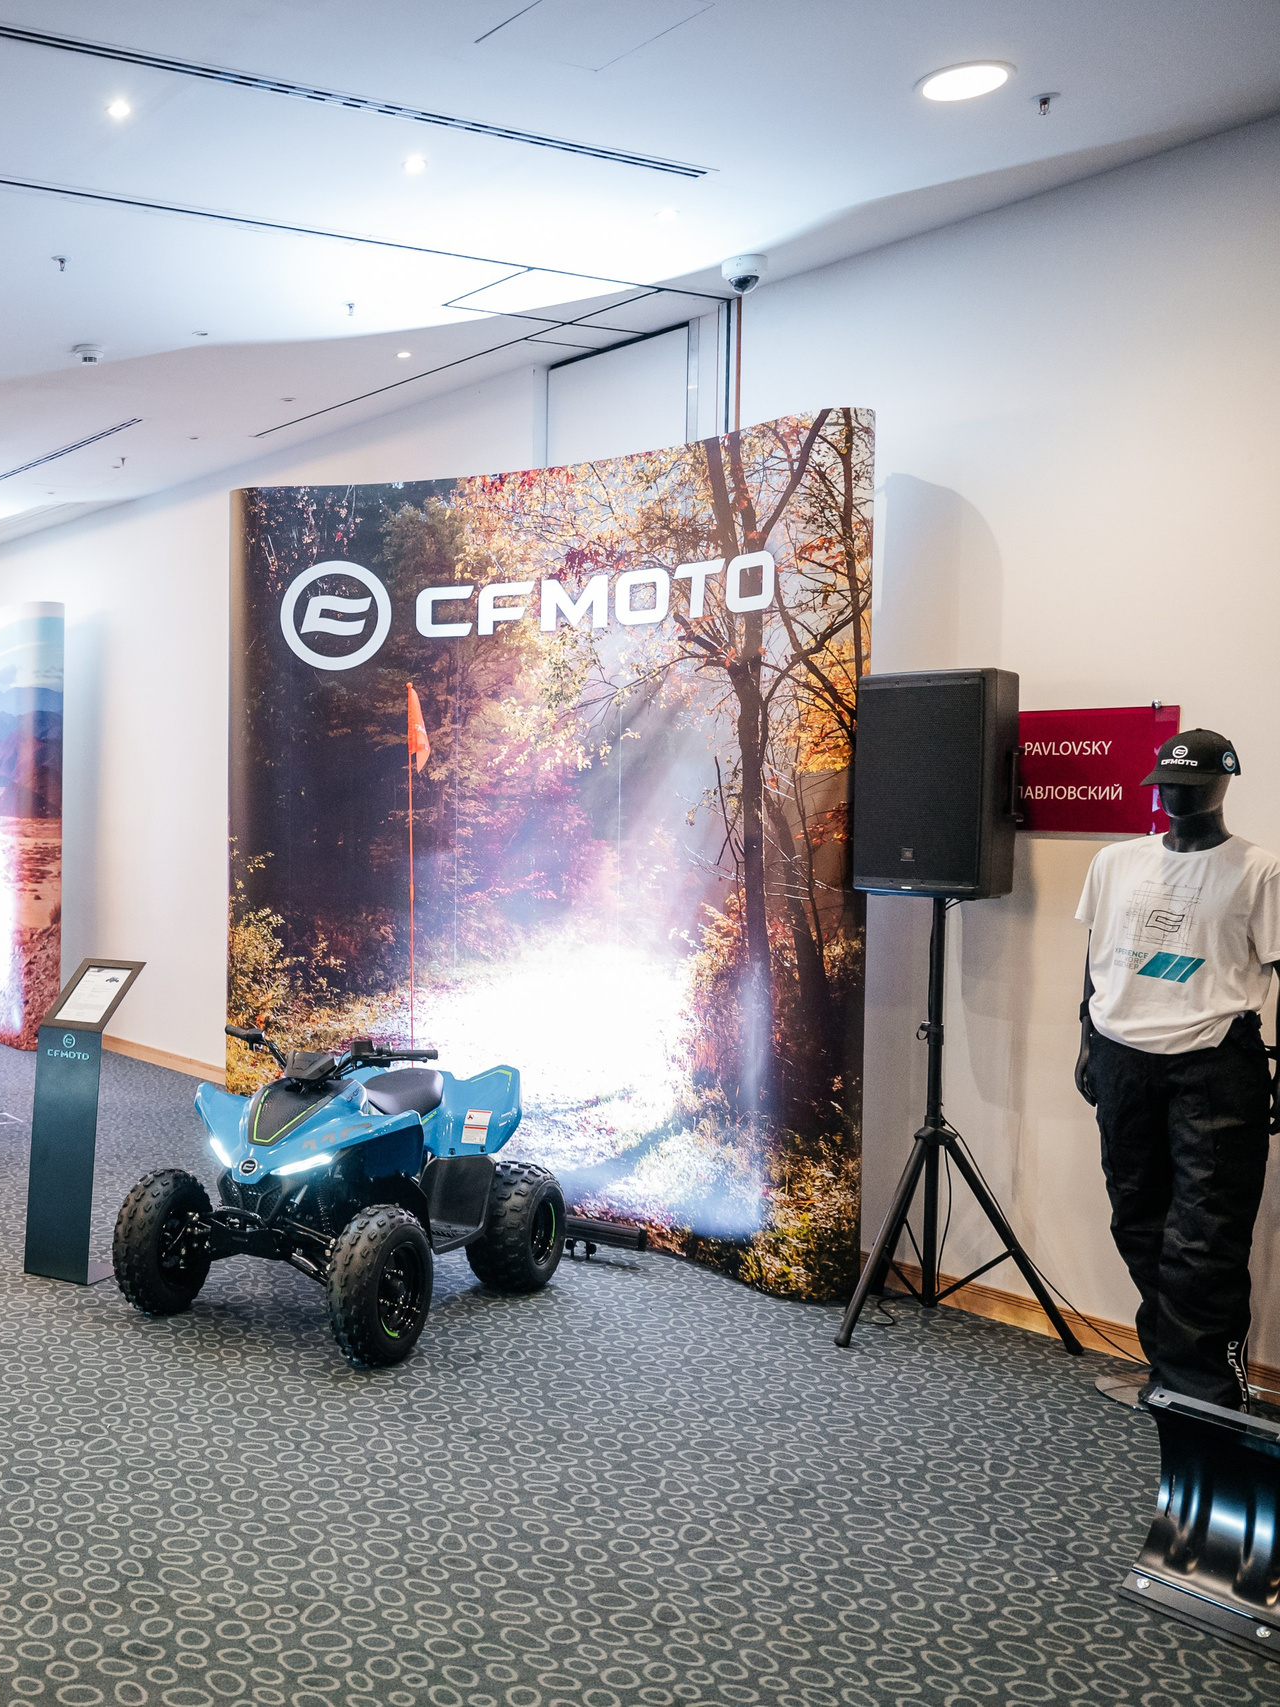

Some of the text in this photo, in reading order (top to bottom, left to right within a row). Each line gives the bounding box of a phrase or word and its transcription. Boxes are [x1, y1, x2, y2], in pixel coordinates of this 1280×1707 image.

[415, 550, 776, 638] CFMOTO
[1024, 740, 1112, 756] PAVLOVSKY
[47, 1048, 90, 1061] CFMOTO
